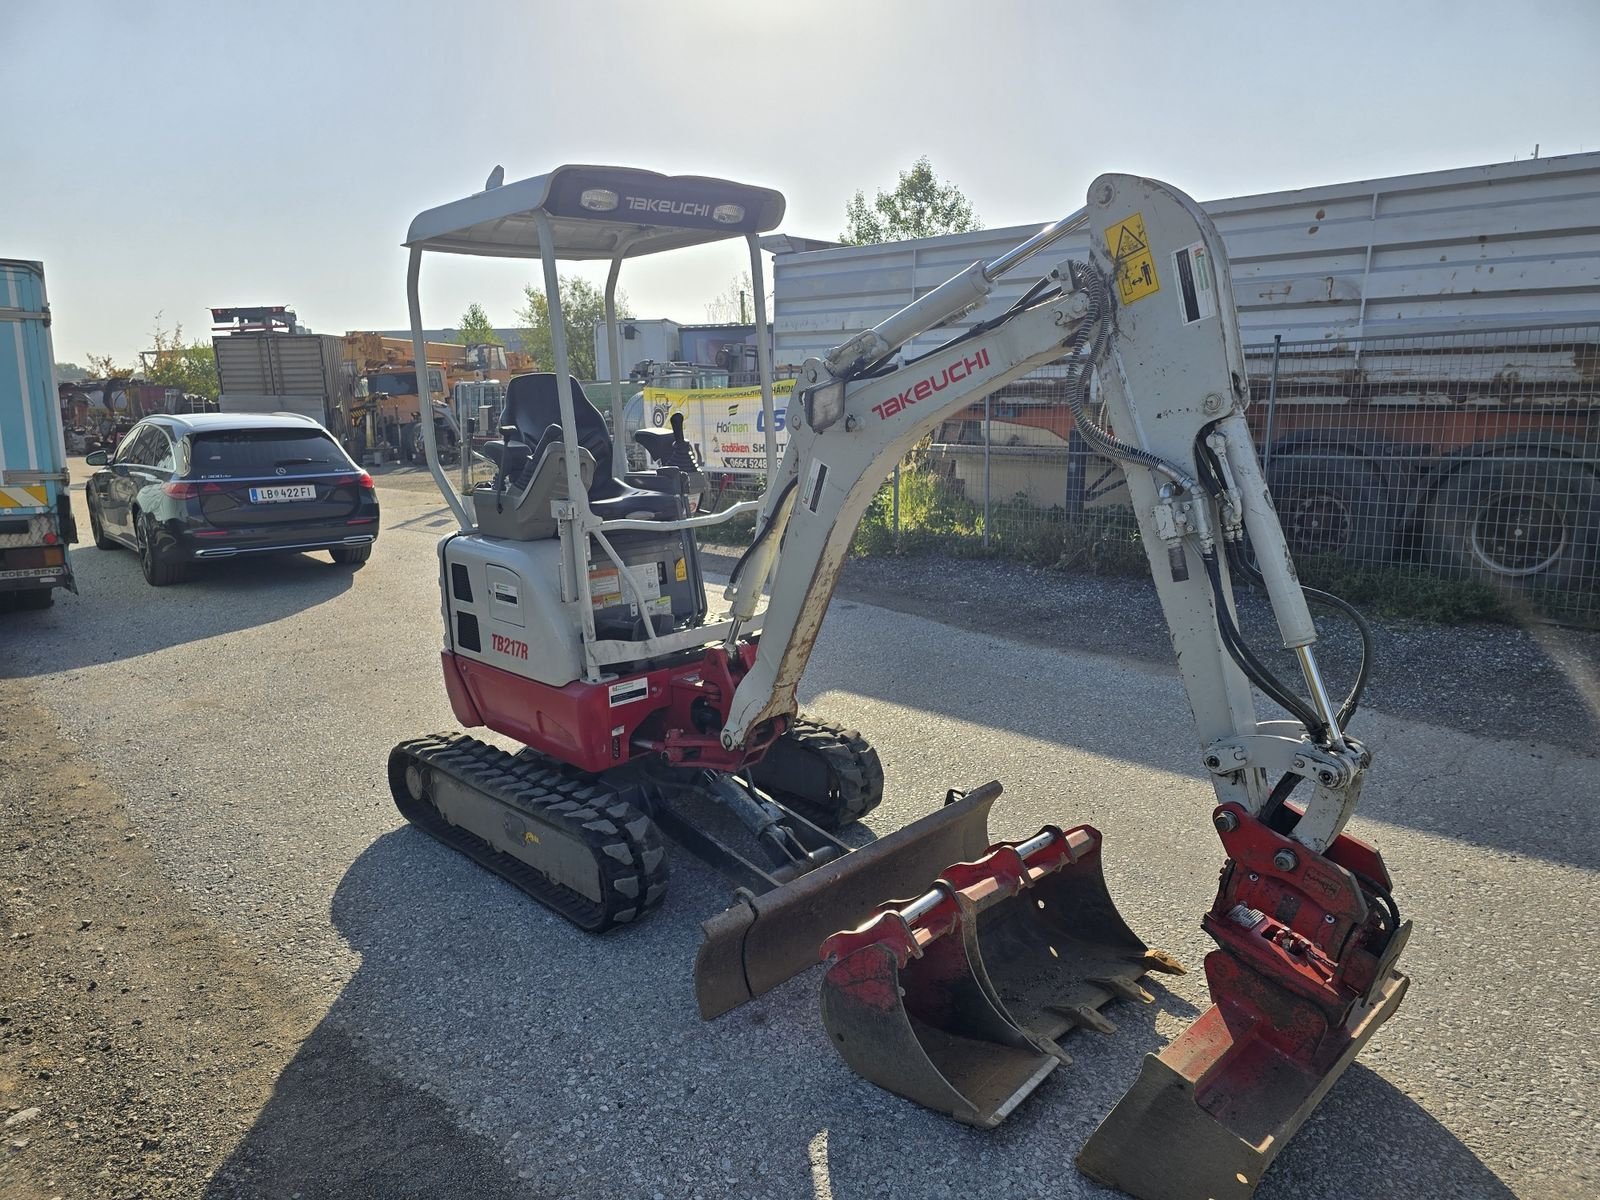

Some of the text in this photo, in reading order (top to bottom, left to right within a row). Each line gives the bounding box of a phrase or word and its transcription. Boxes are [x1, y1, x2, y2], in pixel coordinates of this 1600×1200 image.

[729, 458, 748, 468] 0664
[261, 489, 273, 499] LB
[1, 568, 61, 577] EDES-BENZ
[492, 633, 528, 660] TB217R
